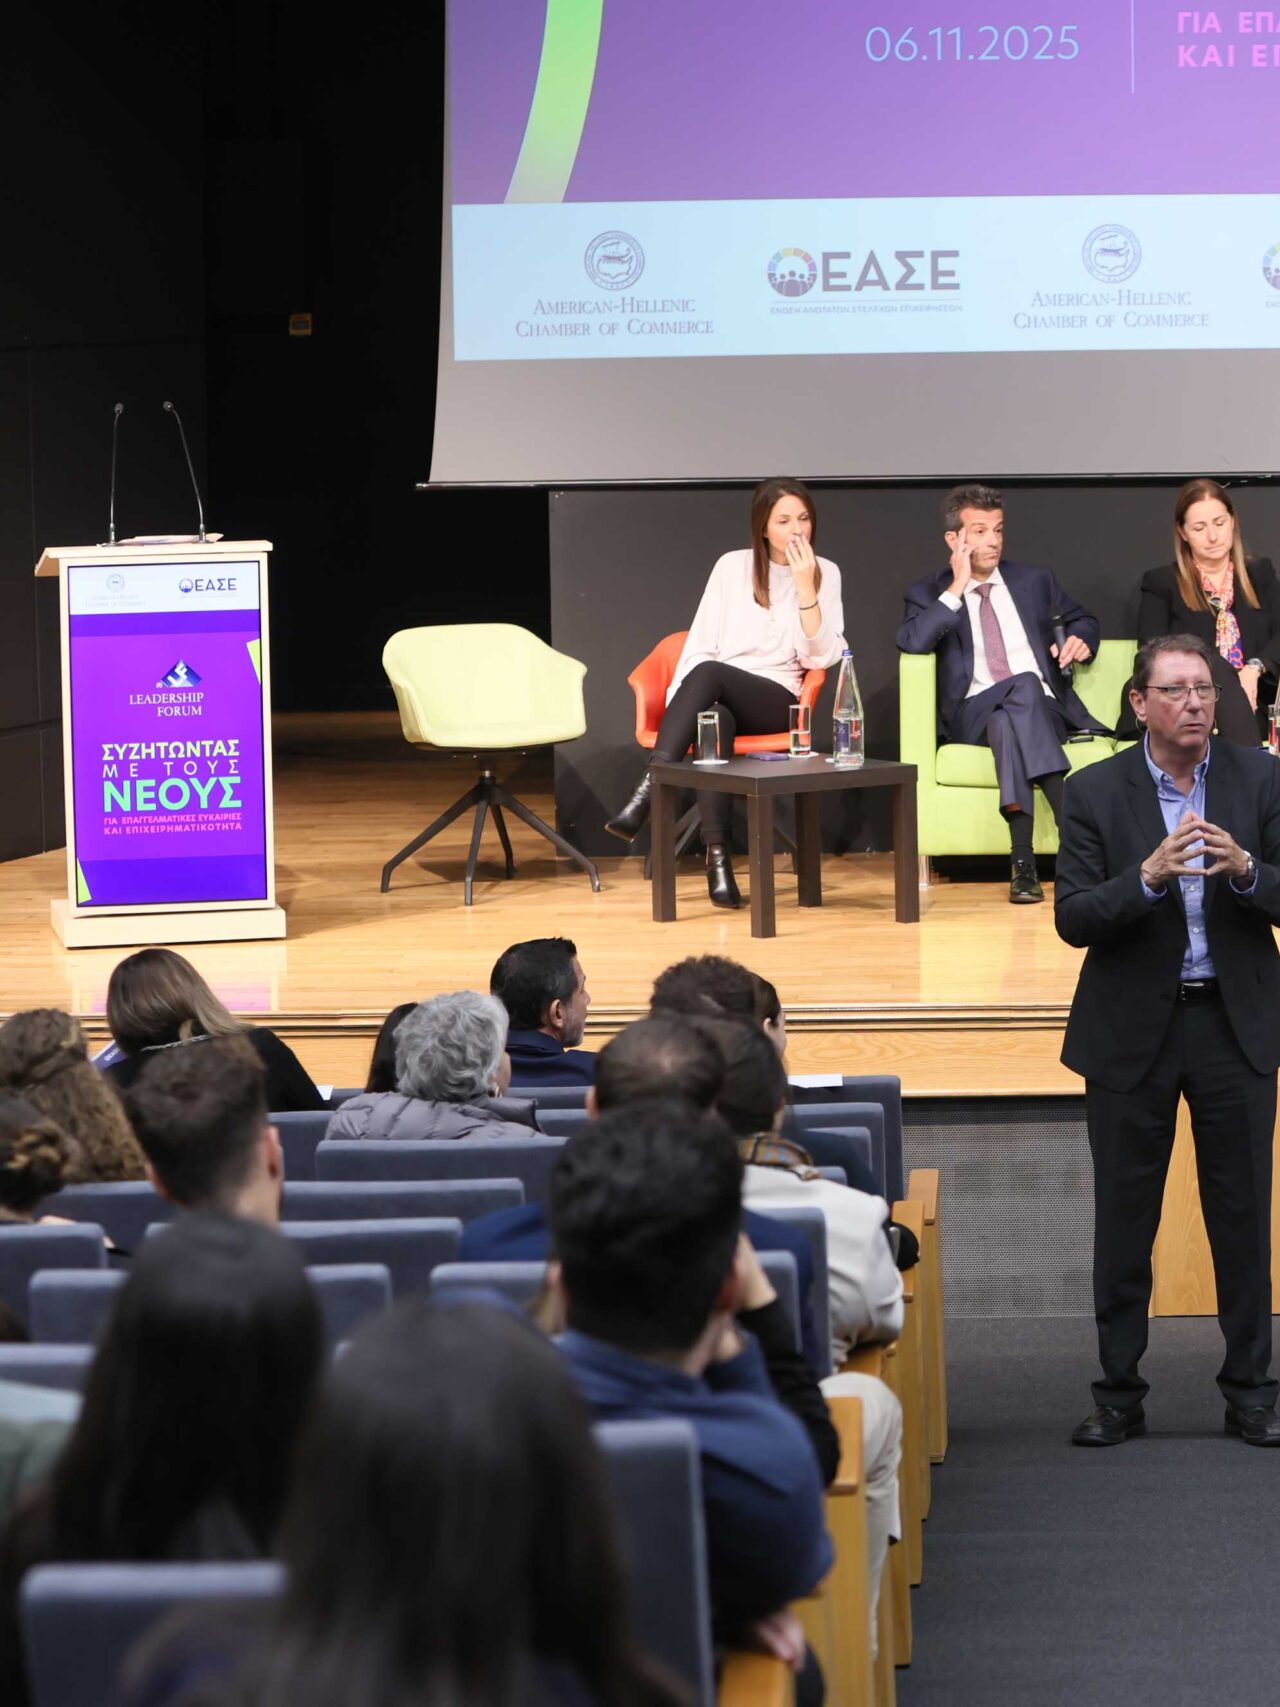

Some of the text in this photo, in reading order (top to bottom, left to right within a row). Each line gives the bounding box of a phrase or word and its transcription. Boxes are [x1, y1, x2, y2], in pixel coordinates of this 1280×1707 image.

[1177, 11, 1222, 33] ΓΙΑ
[865, 25, 1080, 62] 06.11.2025
[1177, 44, 1235, 67] ΚΑΙ
[822, 249, 961, 292] ΕΑΣΕ
[533, 296, 696, 315] AMERICAN-HELLENIC
[1030, 289, 1192, 308] AMERICAN-HELLENIC
[515, 318, 715, 337] CHAMBER OF COMMERCE
[1013, 311, 1210, 329] CHAMBER OF COMMERCE
[195, 578, 237, 592] ΕΑΣΕ
[129, 692, 204, 705] LEADERSHIP
[157, 705, 202, 717] FORUM
[102, 739, 240, 761] ΣΥΖΗΤΩΝΤΑΣ
[102, 759, 239, 778] ΜΕ ΤΟΥΣ
[103, 776, 242, 812] ΝΕΟΥΣ
[104, 812, 242, 825] ΓΙΑ ΕΠΑΓΓΕΛΜΑΤΙΚΕΣ ΕΥΚΑΙΡΙΕΣ
[104, 822, 242, 835] ΚΑΙ ΕΠΙΧΕΙΡΗΜΑΤΙΚΟΤΗΤΑ
